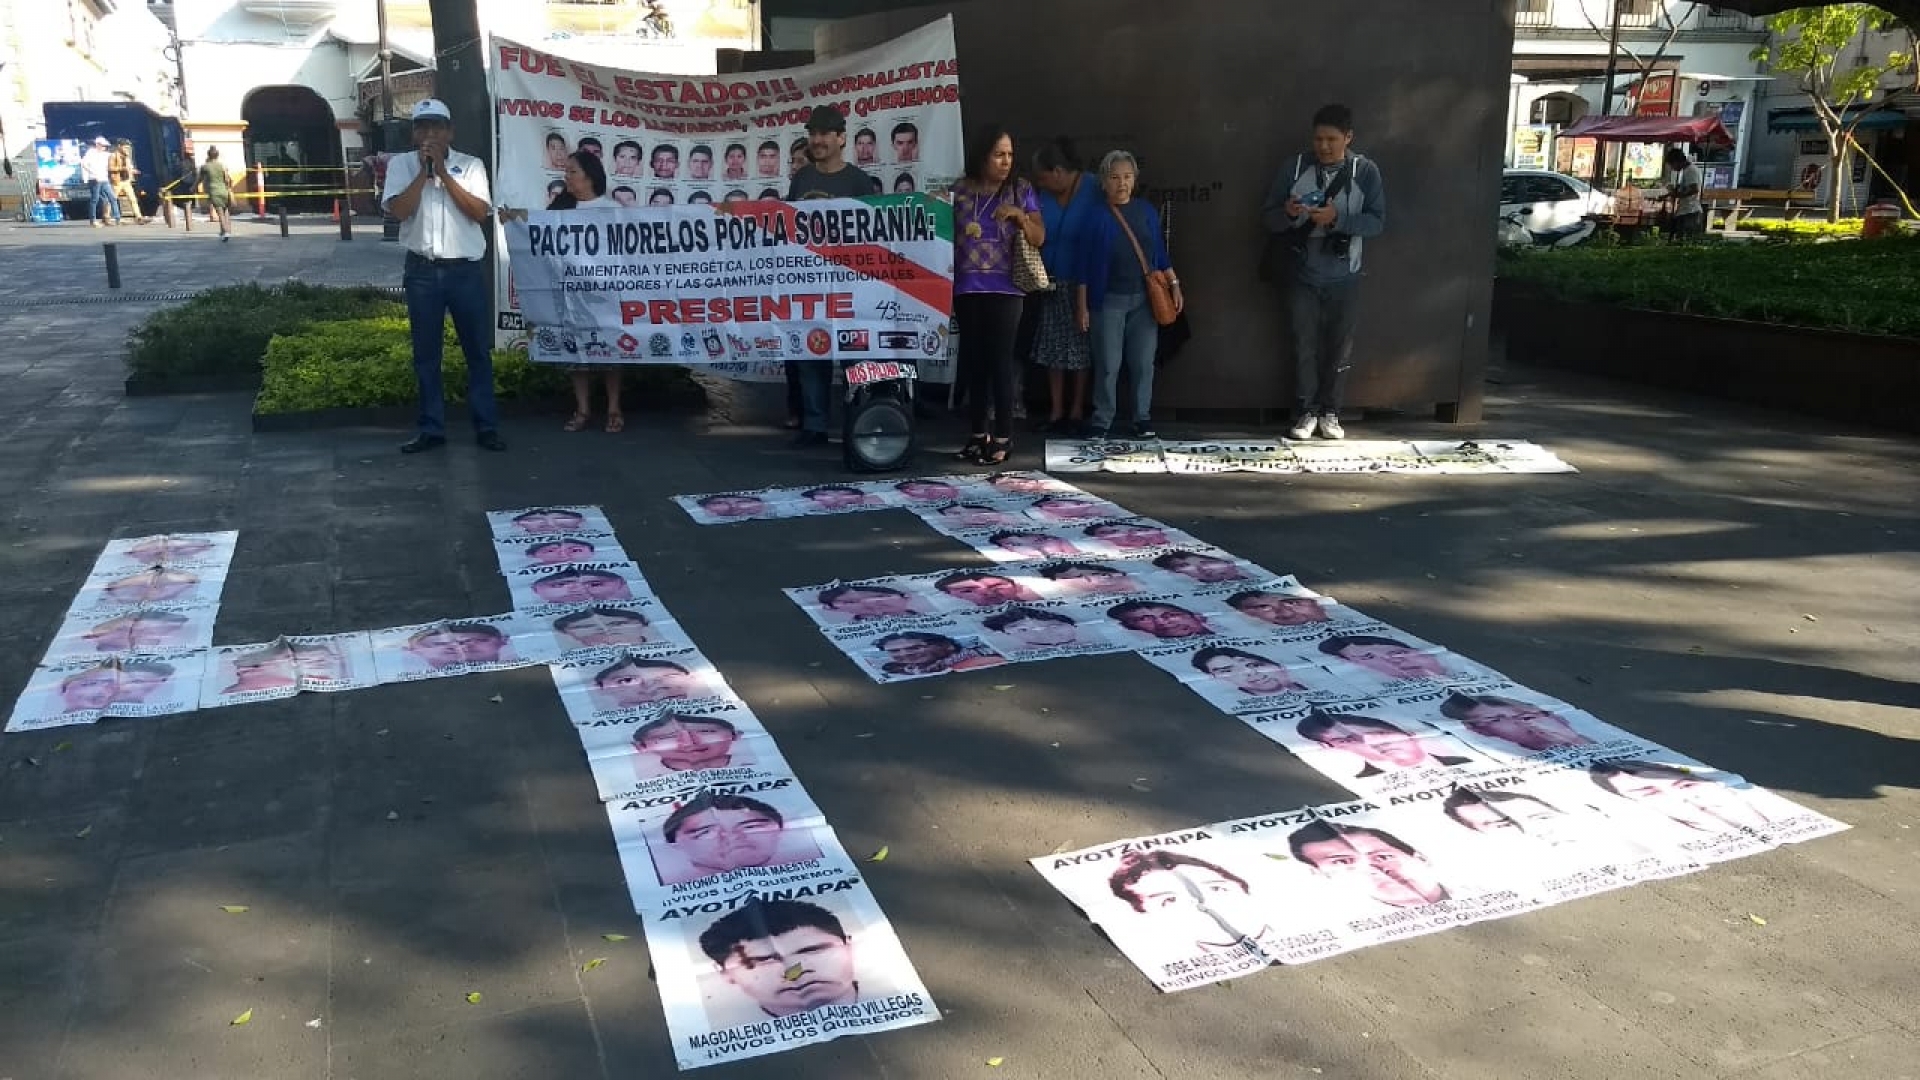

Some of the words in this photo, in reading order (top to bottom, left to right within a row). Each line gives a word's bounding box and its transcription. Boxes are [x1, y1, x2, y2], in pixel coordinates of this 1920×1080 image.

[499, 46, 566, 78] FUE
[571, 63, 609, 91] EL
[809, 59, 959, 97] NORMALISTAS
[568, 105, 596, 123] SE
[600, 108, 640, 129] LOS
[529, 223, 600, 256] PACTO
[607, 218, 709, 255] MORELOS
[714, 215, 757, 250] POR
[762, 210, 788, 247] LA
[795, 197, 937, 245] SOBERANÍA:
[564, 263, 651, 277] ALIMENTARIA
[653, 263, 663, 275] Y
[665, 259, 747, 275] ENERGÉTCA,
[750, 256, 774, 270] LOS
[776, 253, 850, 269] DERECHOS
[855, 252, 873, 266] DE
[878, 251, 906, 265] LOS
[665, 279, 674, 290] Y
[676, 277, 701, 289] LAS
[704, 271, 774, 289] GARANTÍAS
[776, 269, 916, 285] CONSTITUCIONALES
[619, 292, 856, 325] PRESENTE
[838, 330, 868, 344] OPT
[672, 874, 720, 894] ANTONIO
[720, 866, 770, 884] SANTANA
[770, 860, 821, 877] MAESTRO
[723, 879, 755, 894] LOS
[757, 867, 844, 887] QUEREMOS
[689, 1022, 772, 1050] MAGDALENO
[774, 1012, 819, 1032] RUBEN
[818, 1003, 862, 1022] LAURO
[861, 992, 924, 1015] VILLEGAS
[782, 1026, 819, 1043] LOS
[821, 1007, 924, 1033] QUEREMOS
